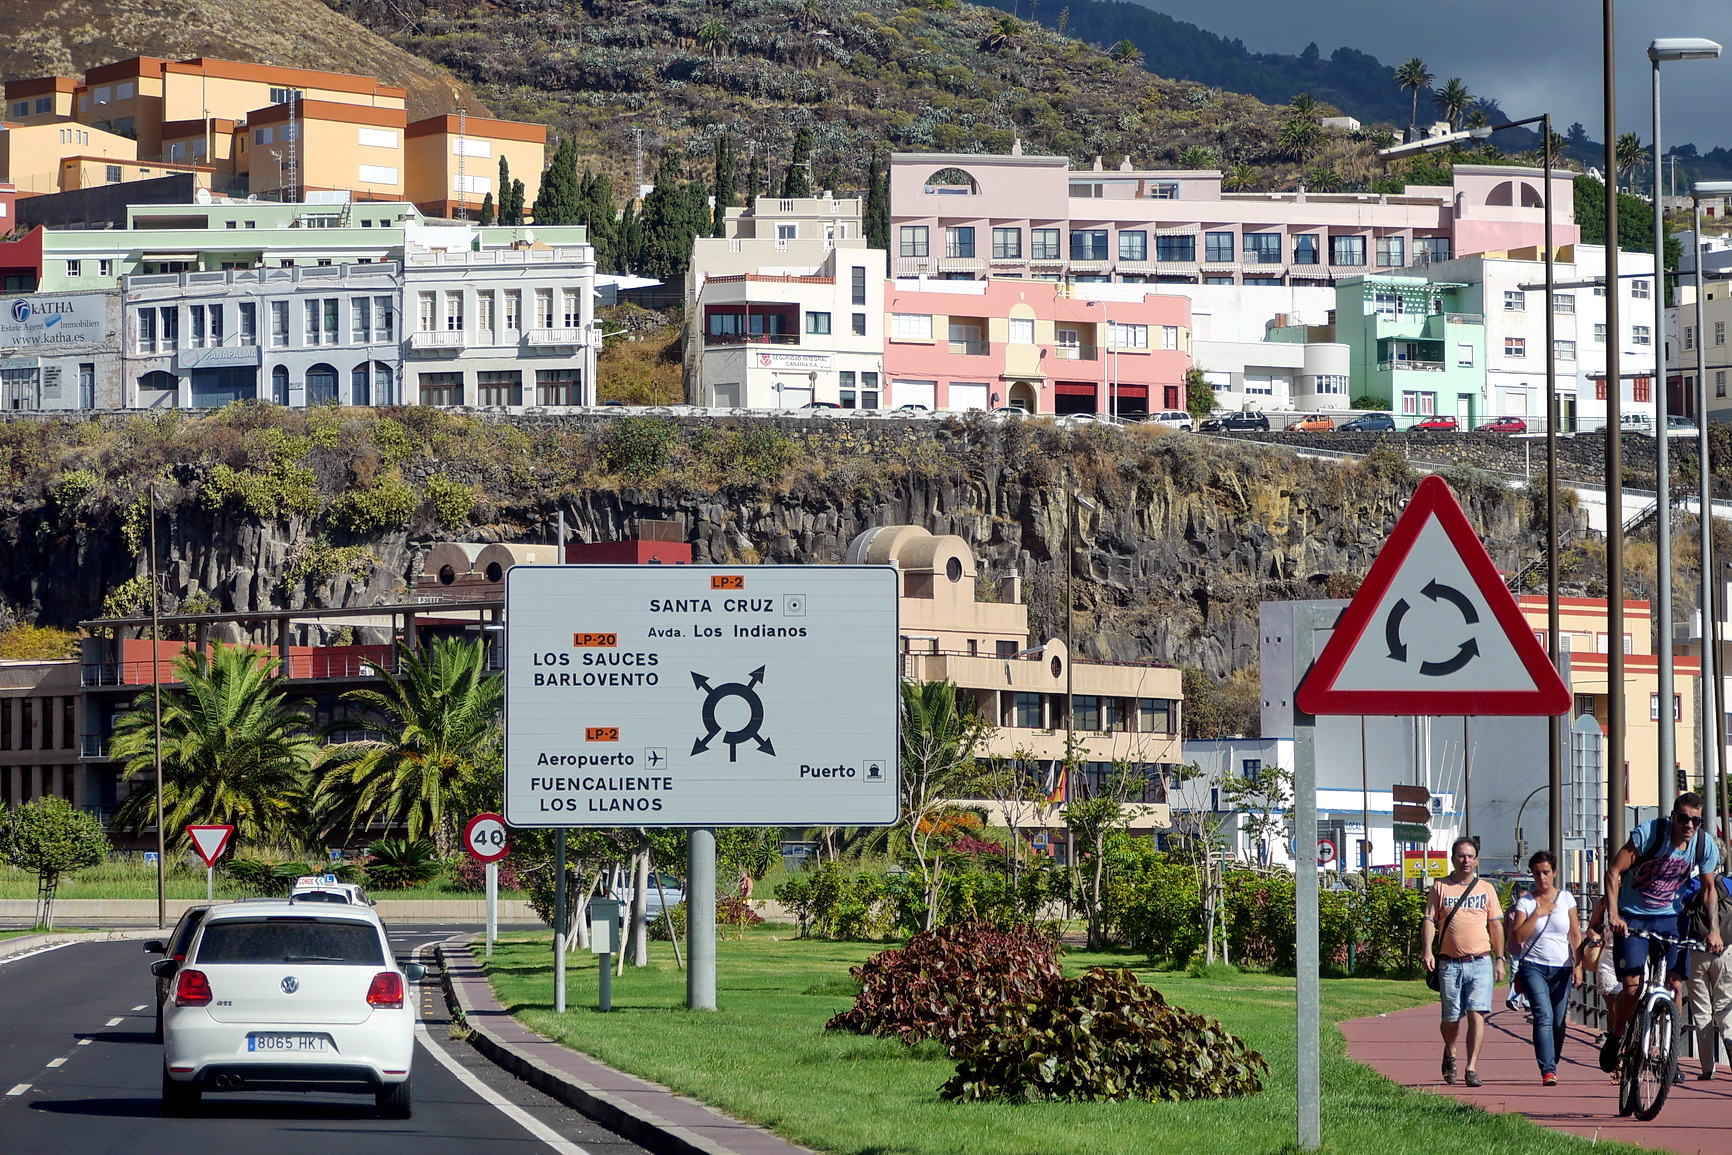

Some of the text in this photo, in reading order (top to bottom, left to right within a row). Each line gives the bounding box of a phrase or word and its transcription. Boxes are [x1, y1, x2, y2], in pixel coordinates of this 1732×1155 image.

[1, 323, 44, 333] Estate Agent
[60, 319, 100, 329] Immobilien
[12, 331, 85, 345] www.katha.es
[205, 348, 257, 360] PANAPALMA
[772, 354, 802, 362] SEGURIDAD
[712, 576, 743, 589] LP-2
[650, 599, 774, 613] SANTA CRUZ
[648, 624, 807, 638] Avda. Los Indianos
[574, 634, 617, 647] LP-20
[534, 653, 659, 666] LOS SAUCES
[534, 673, 659, 687] BARLOVENTO
[587, 728, 618, 741] LP-2
[537, 752, 635, 769] Aeropuerto
[800, 764, 856, 778] Puerto
[531, 777, 673, 791] FUENCALIENTE
[540, 798, 663, 812] LOS LLANOS
[473, 829, 504, 846] 40
[257, 1036, 326, 1051] 8065 HKT
